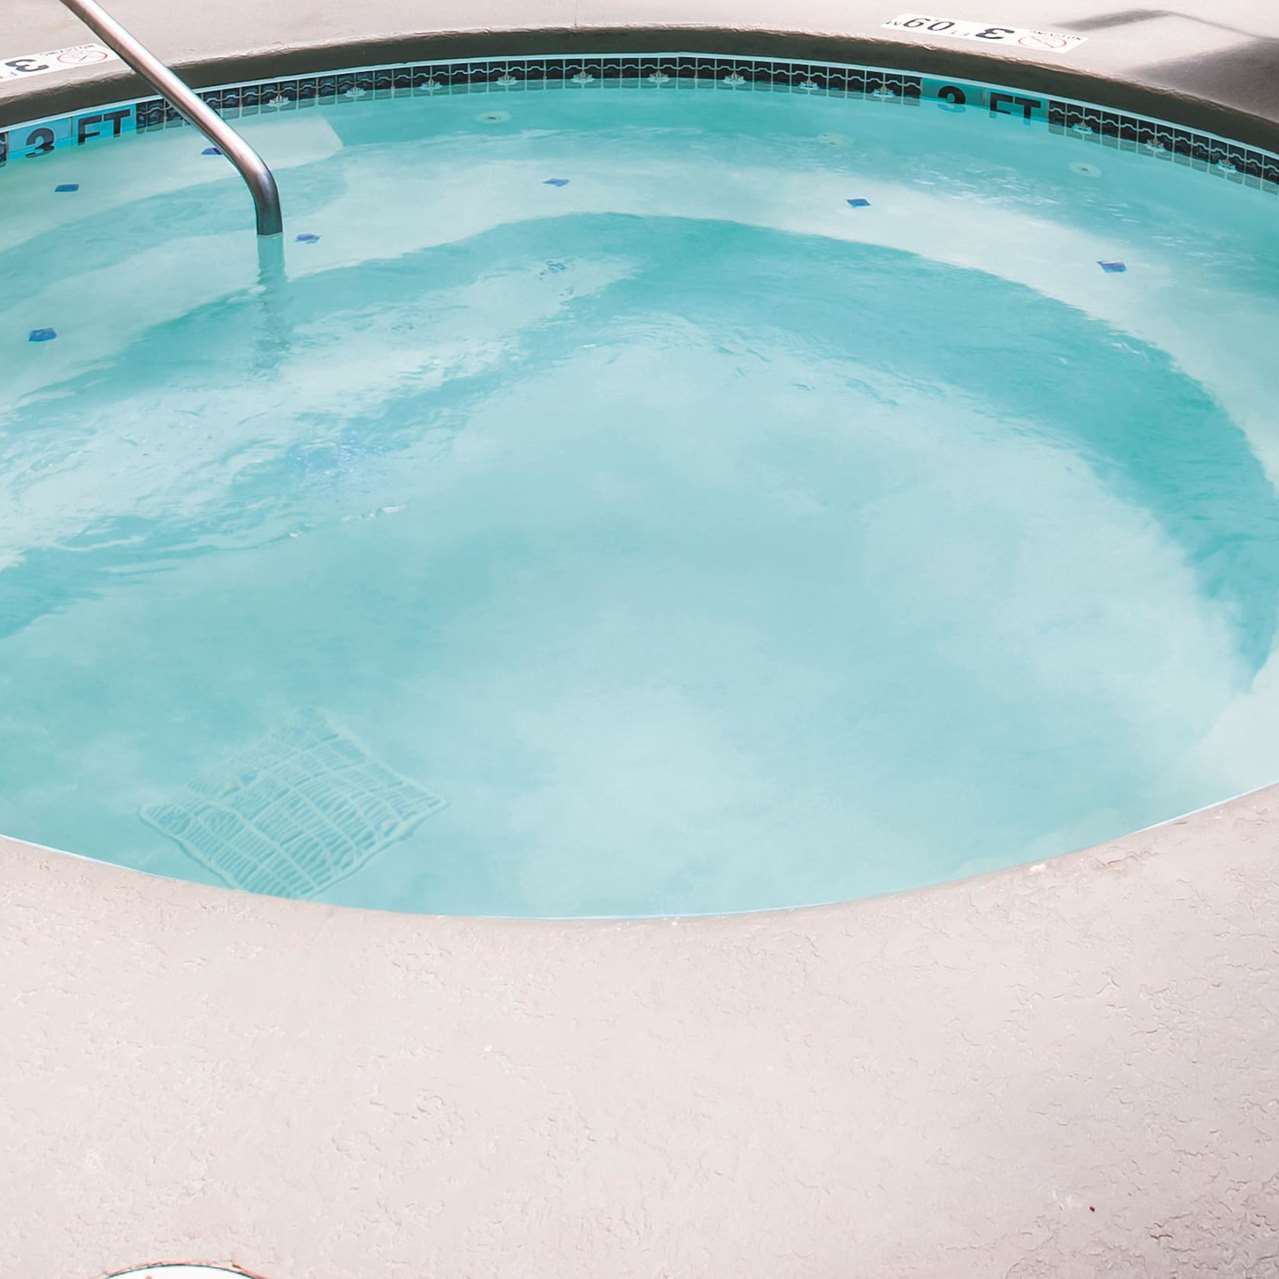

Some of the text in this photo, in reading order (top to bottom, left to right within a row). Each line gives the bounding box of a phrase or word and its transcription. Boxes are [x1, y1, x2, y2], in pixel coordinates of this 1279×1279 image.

[975, 28, 1015, 39] 3
[5, 58, 50, 73] 3
[77, 108, 132, 146] FT
